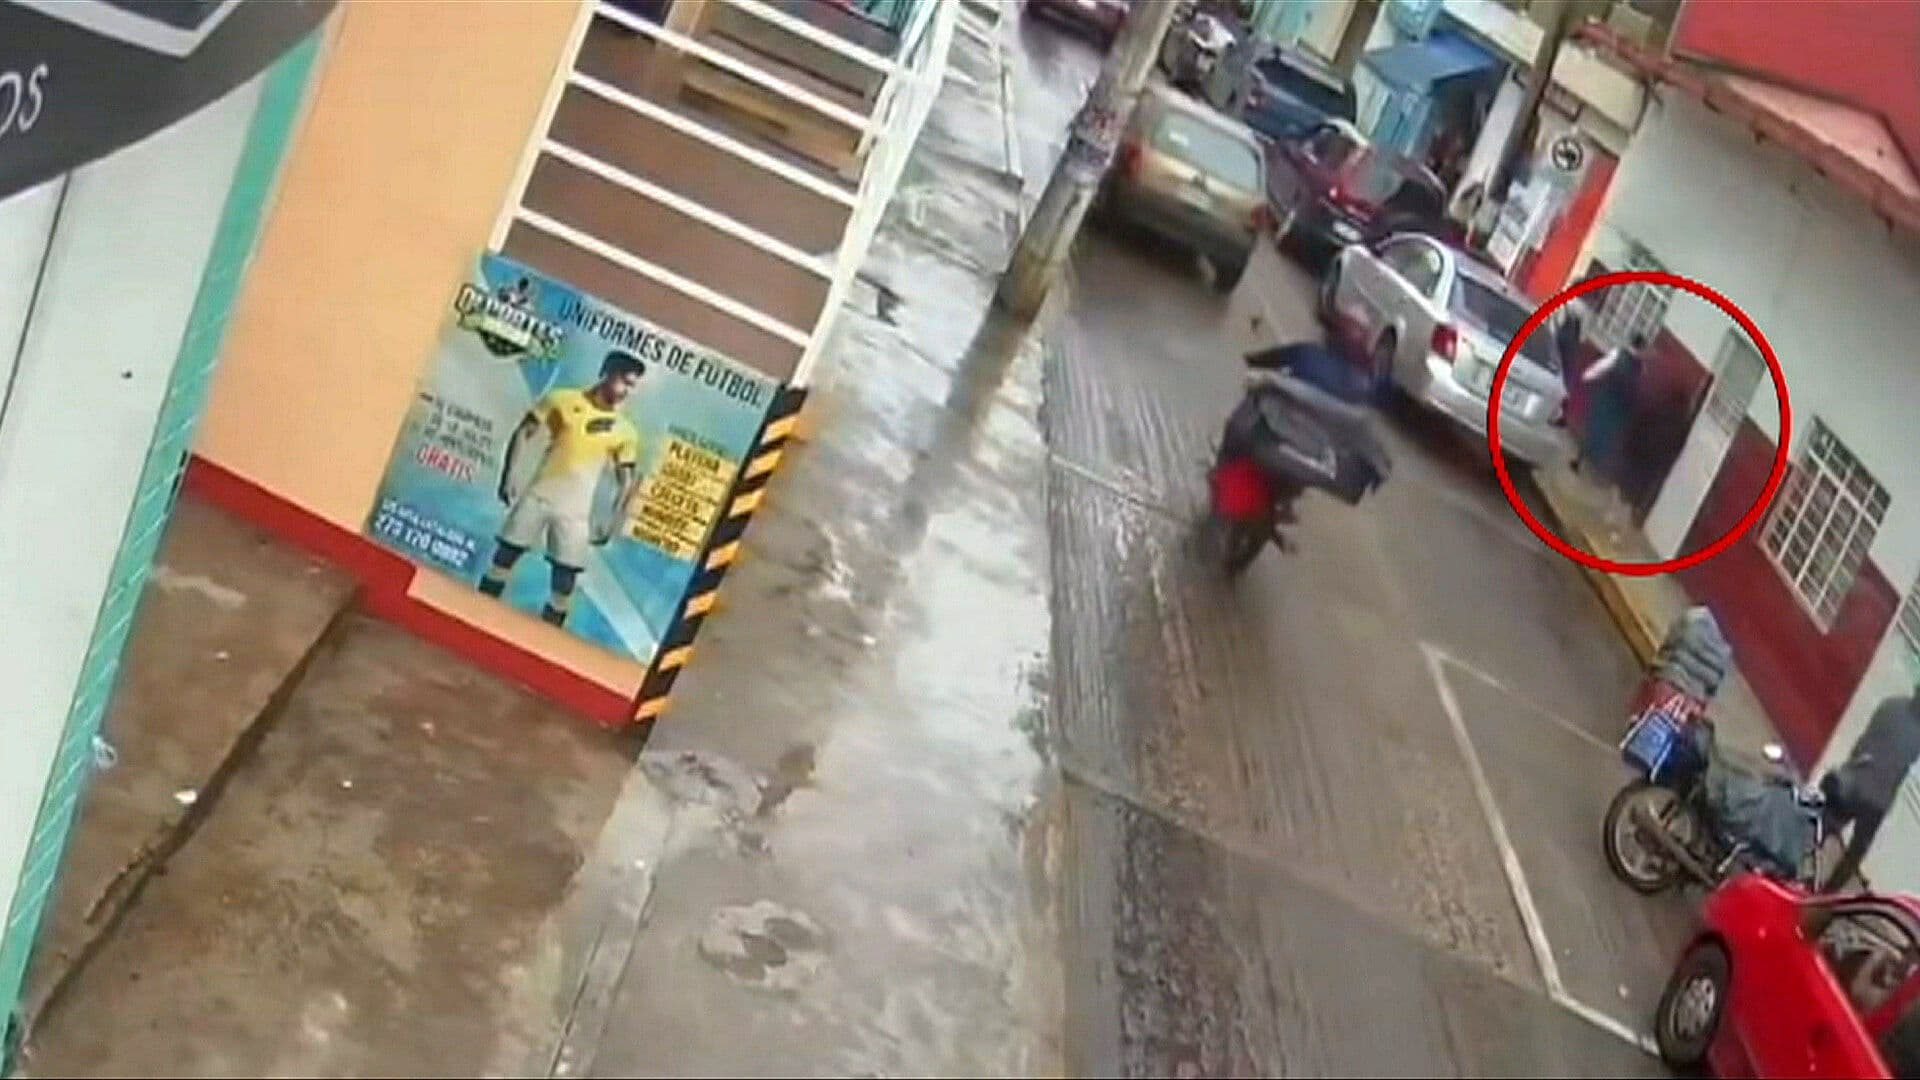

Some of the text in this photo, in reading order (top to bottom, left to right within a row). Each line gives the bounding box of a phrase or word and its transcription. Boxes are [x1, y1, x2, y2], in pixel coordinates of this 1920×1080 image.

[559, 298, 666, 362] UNIFORMES
[666, 345, 696, 375] DE
[416, 444, 475, 483] GRATIS
